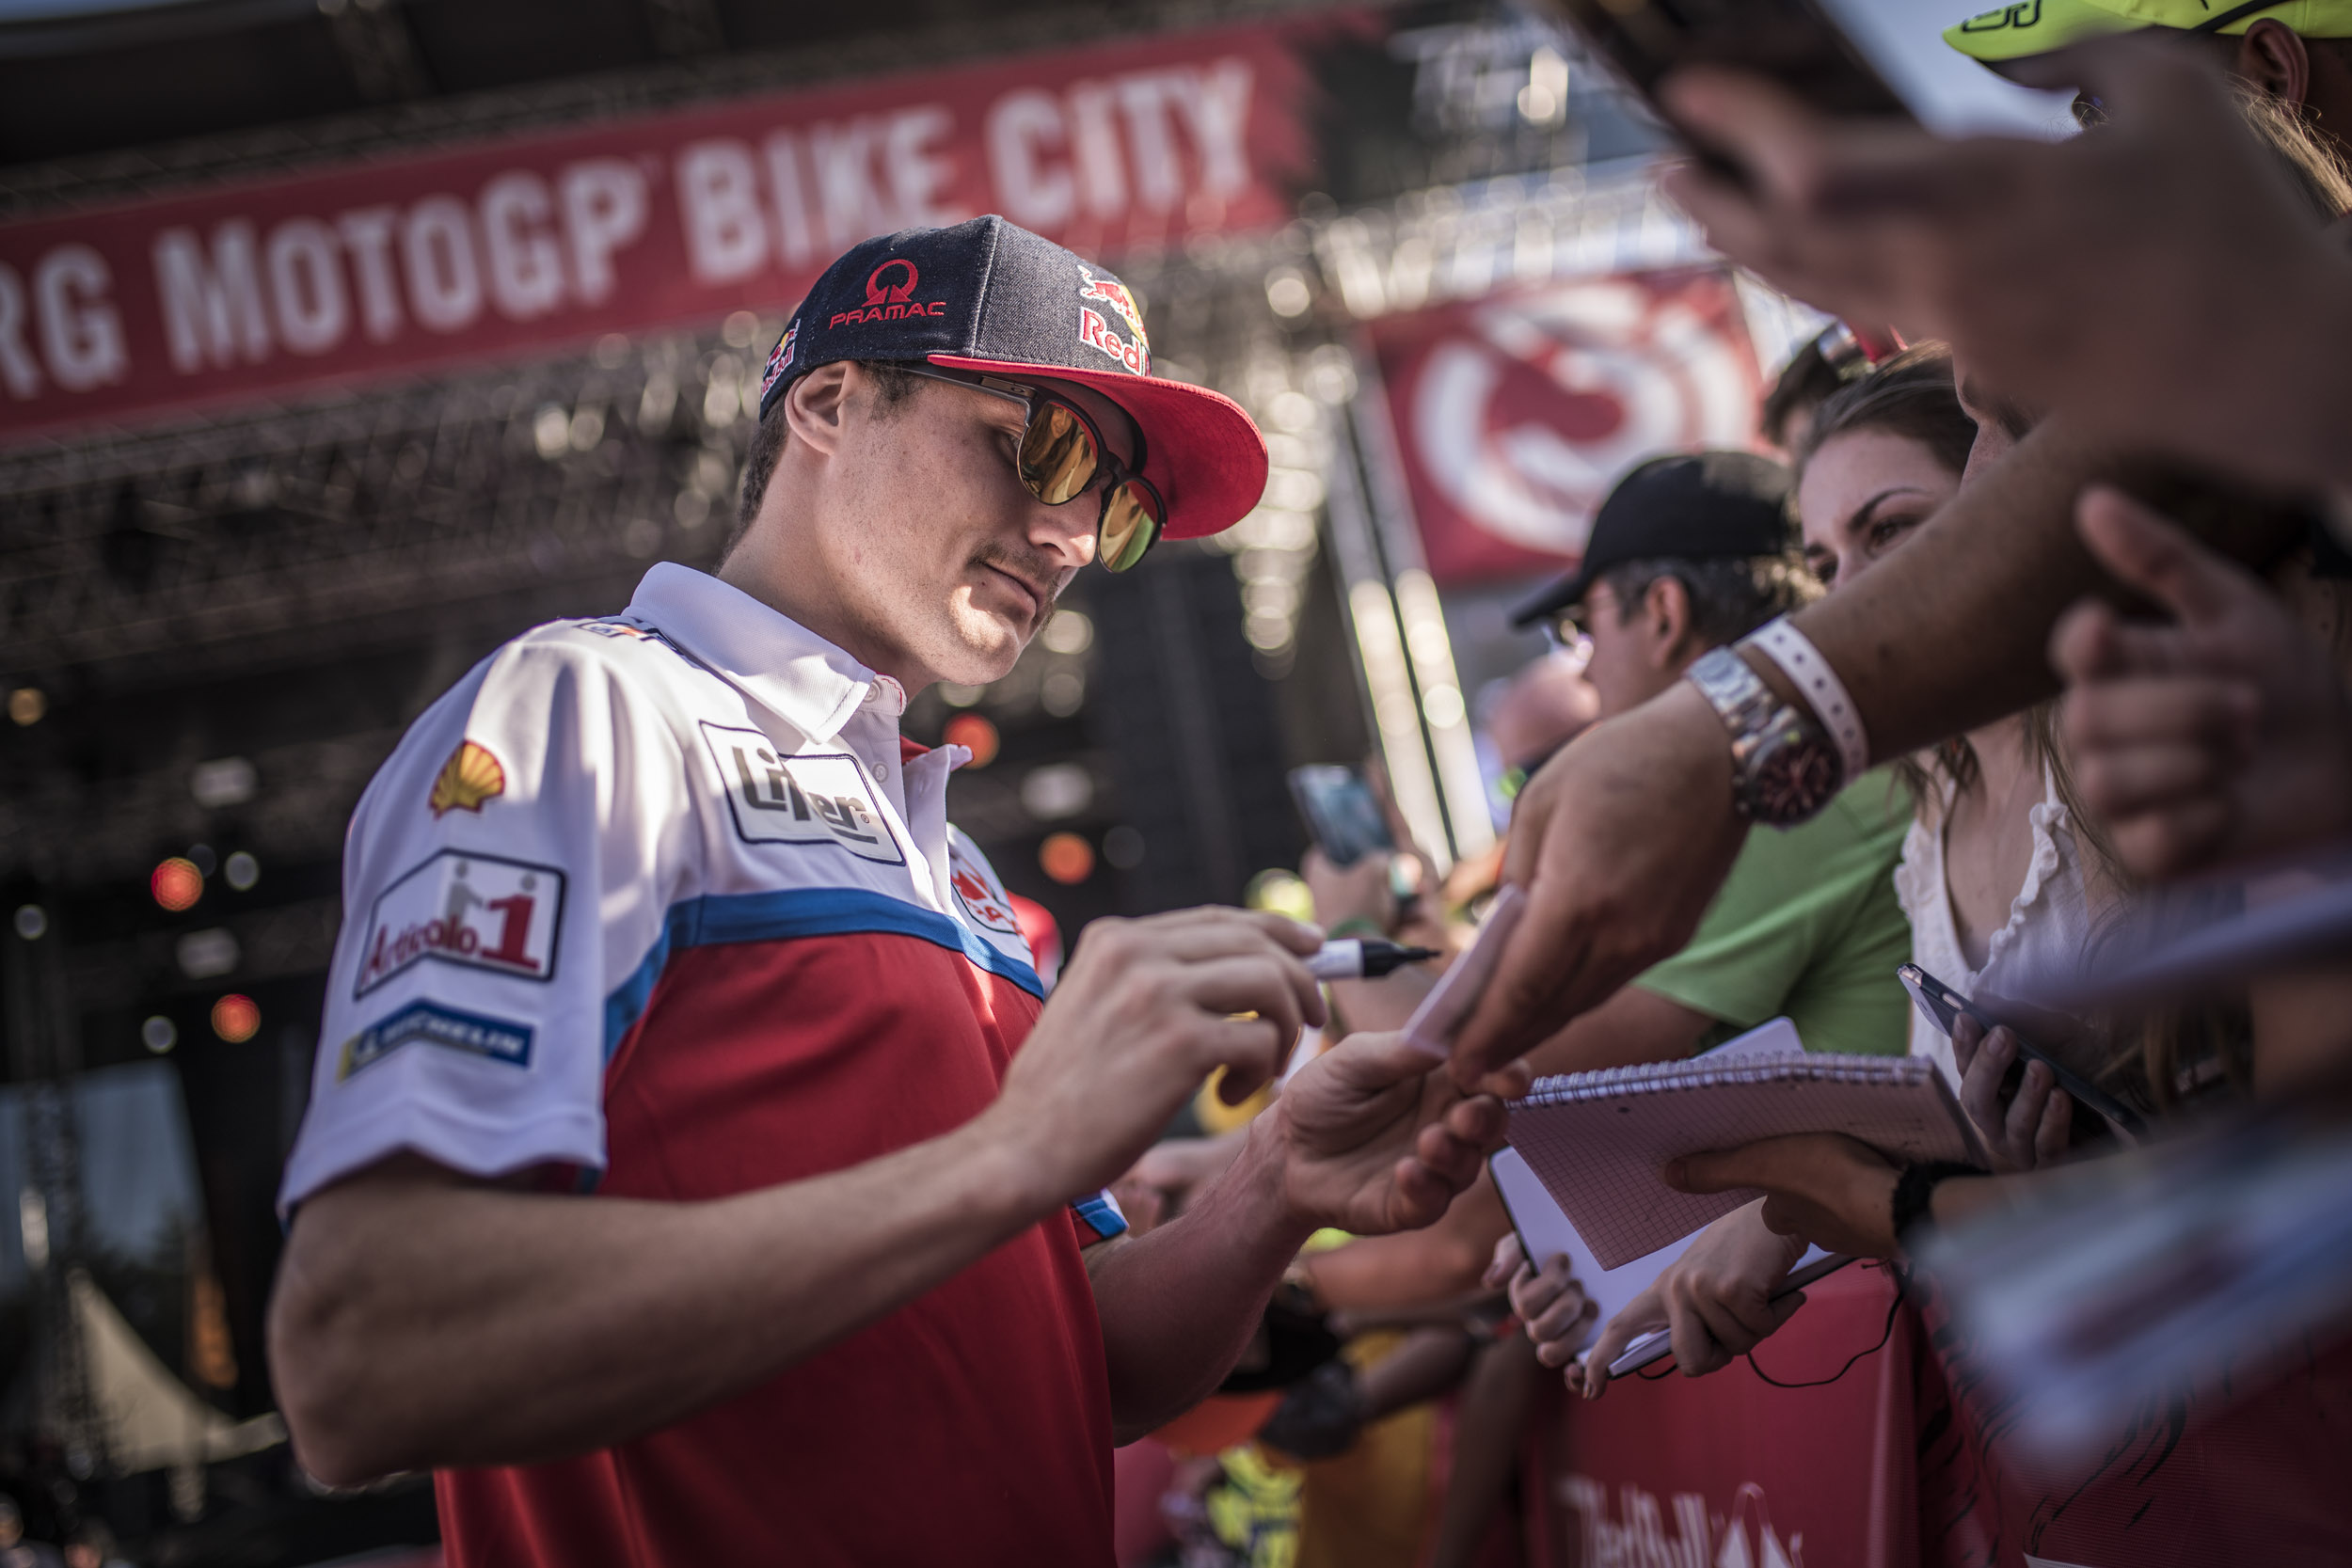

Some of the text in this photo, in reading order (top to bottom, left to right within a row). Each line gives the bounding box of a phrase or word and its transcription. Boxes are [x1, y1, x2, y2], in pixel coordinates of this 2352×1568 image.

[675, 101, 960, 282] BIKE
[984, 56, 1256, 229] CITY
[828, 301, 946, 330] PRAMAC
[1080, 307, 1143, 376] Red
